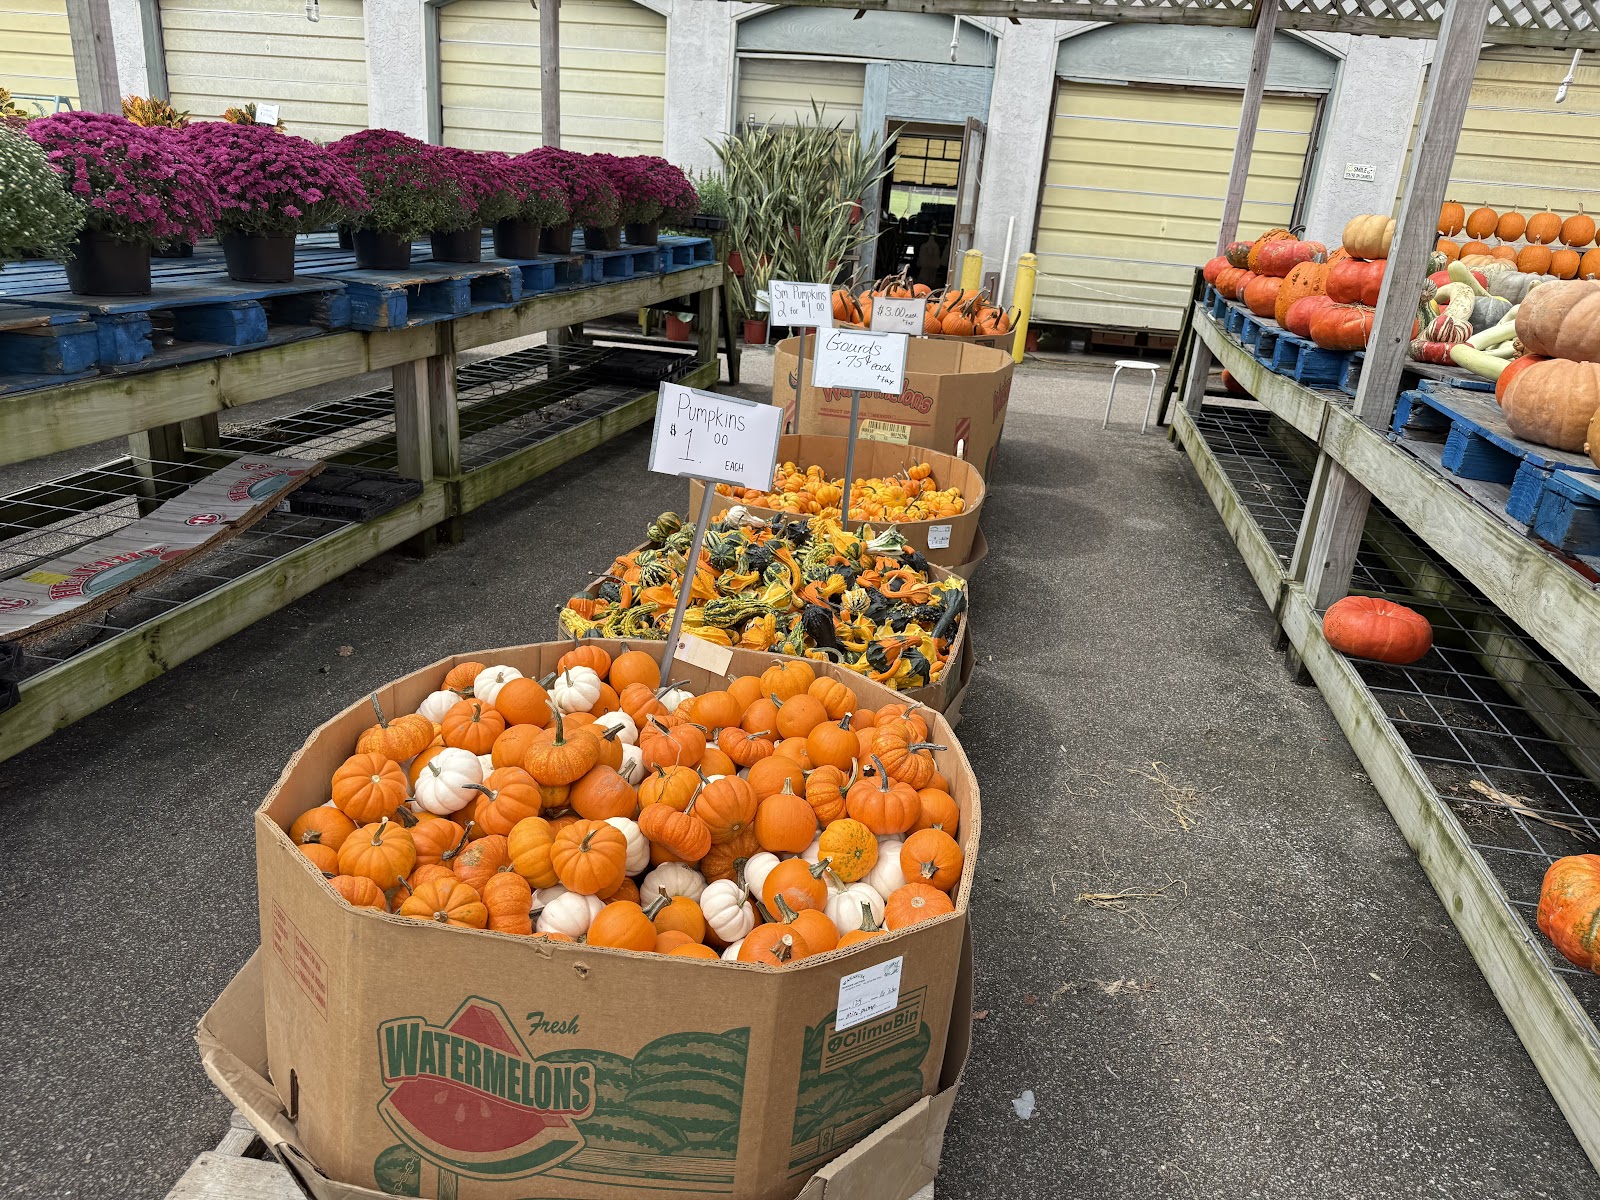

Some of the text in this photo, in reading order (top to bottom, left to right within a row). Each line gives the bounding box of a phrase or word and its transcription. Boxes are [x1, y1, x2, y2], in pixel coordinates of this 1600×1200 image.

[792, 285, 827, 303] Pumpkins
[777, 300, 787, 318] 2
[789, 307, 799, 315] for
[876, 305, 905, 318] $3.00
[825, 332, 882, 356] Gourds
[870, 362, 895, 373] each
[677, 392, 746, 432] Pumpkins
[724, 460, 745, 473] EACH
[525, 1011, 580, 1037] Fresh
[843, 1009, 919, 1048] ClimaBin
[385, 1022, 591, 1111] WATERMELONS
